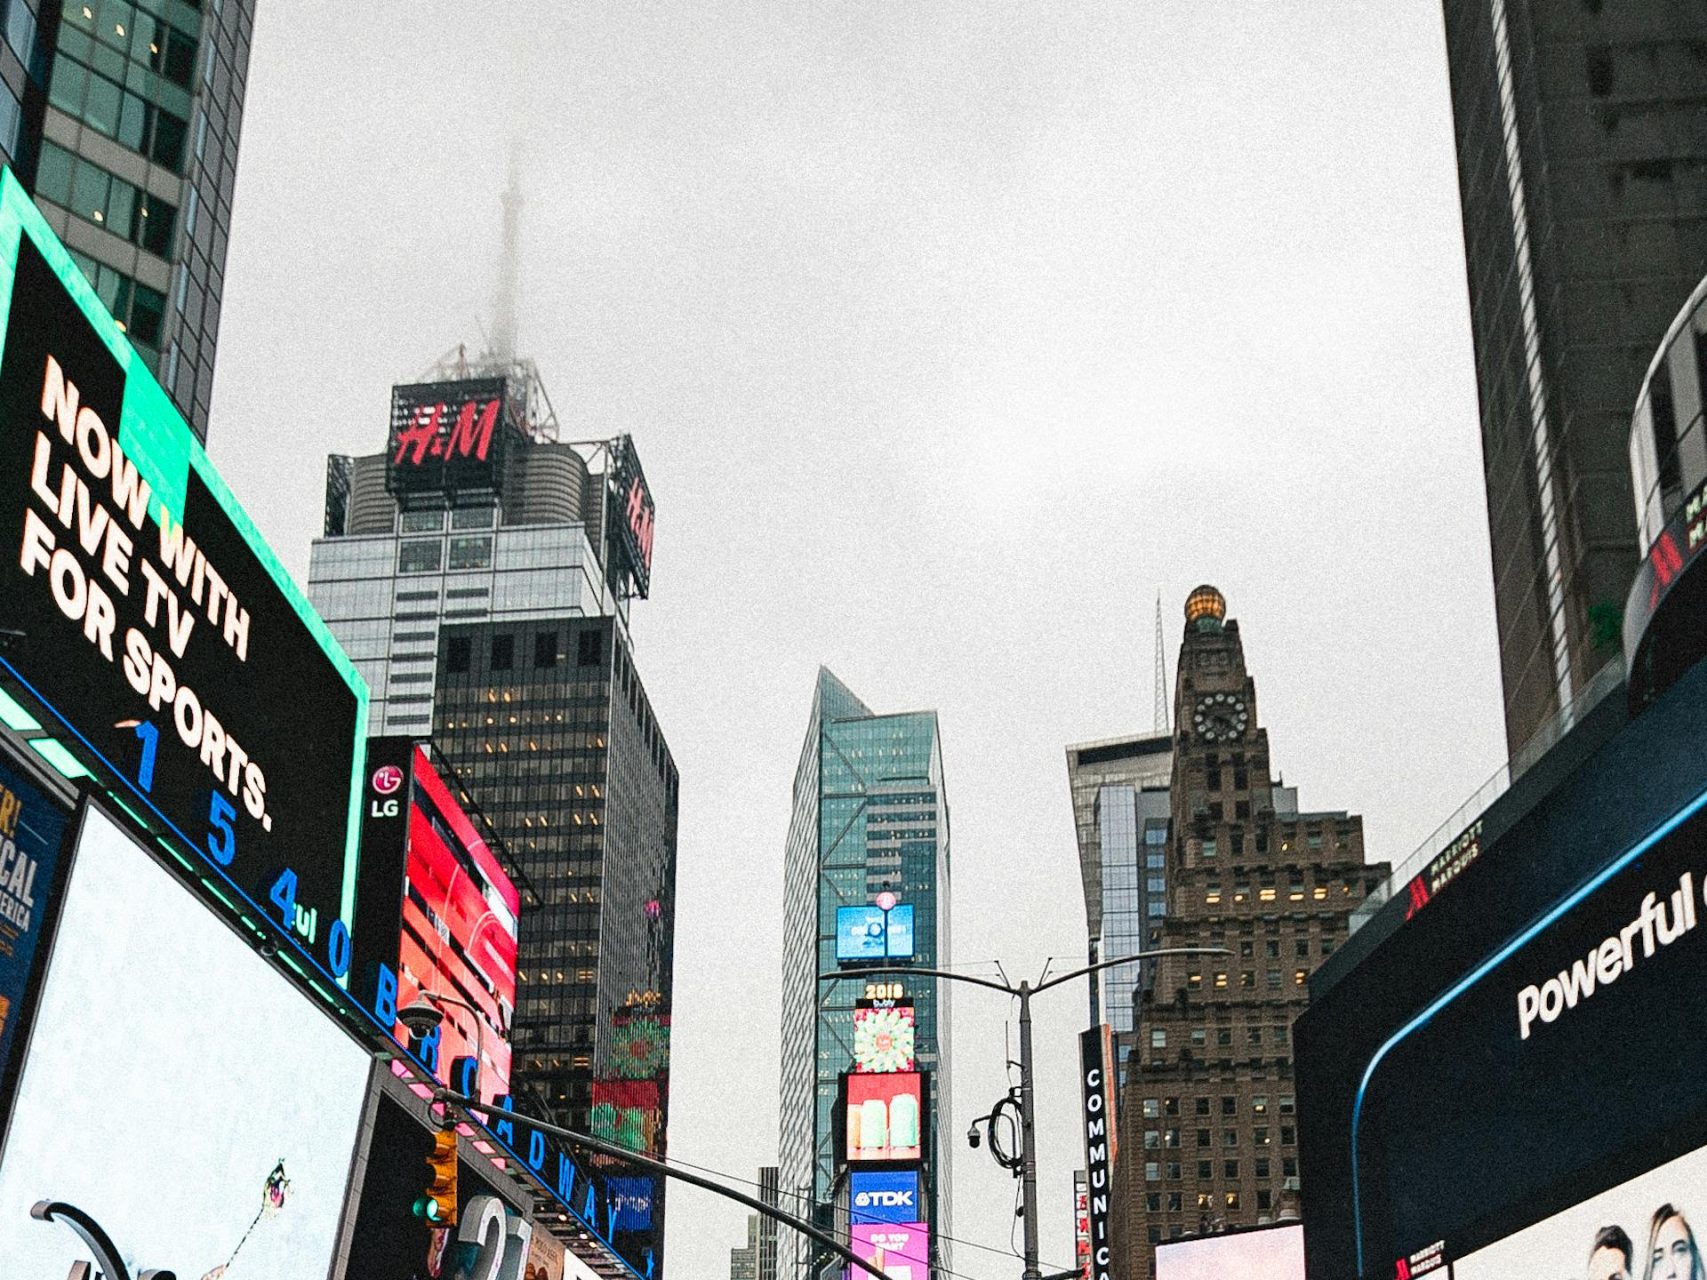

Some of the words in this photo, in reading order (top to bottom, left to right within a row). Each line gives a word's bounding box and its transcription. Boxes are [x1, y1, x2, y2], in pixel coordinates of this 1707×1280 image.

[394, 399, 501, 465] H&M
[41, 354, 152, 531] NOW
[160, 503, 250, 662] WITH
[31, 431, 134, 596] LIVE
[141, 558, 195, 659] TV
[20, 508, 117, 662] FOR
[123, 627, 273, 833] SPORTS.
[371, 800, 399, 818] LG
[1430, 819, 1483, 877] MARRIOTT
[1431, 842, 1479, 896] MARQUIS
[1517, 871, 1697, 1041] powerful
[869, 1190, 914, 1207] TDK
